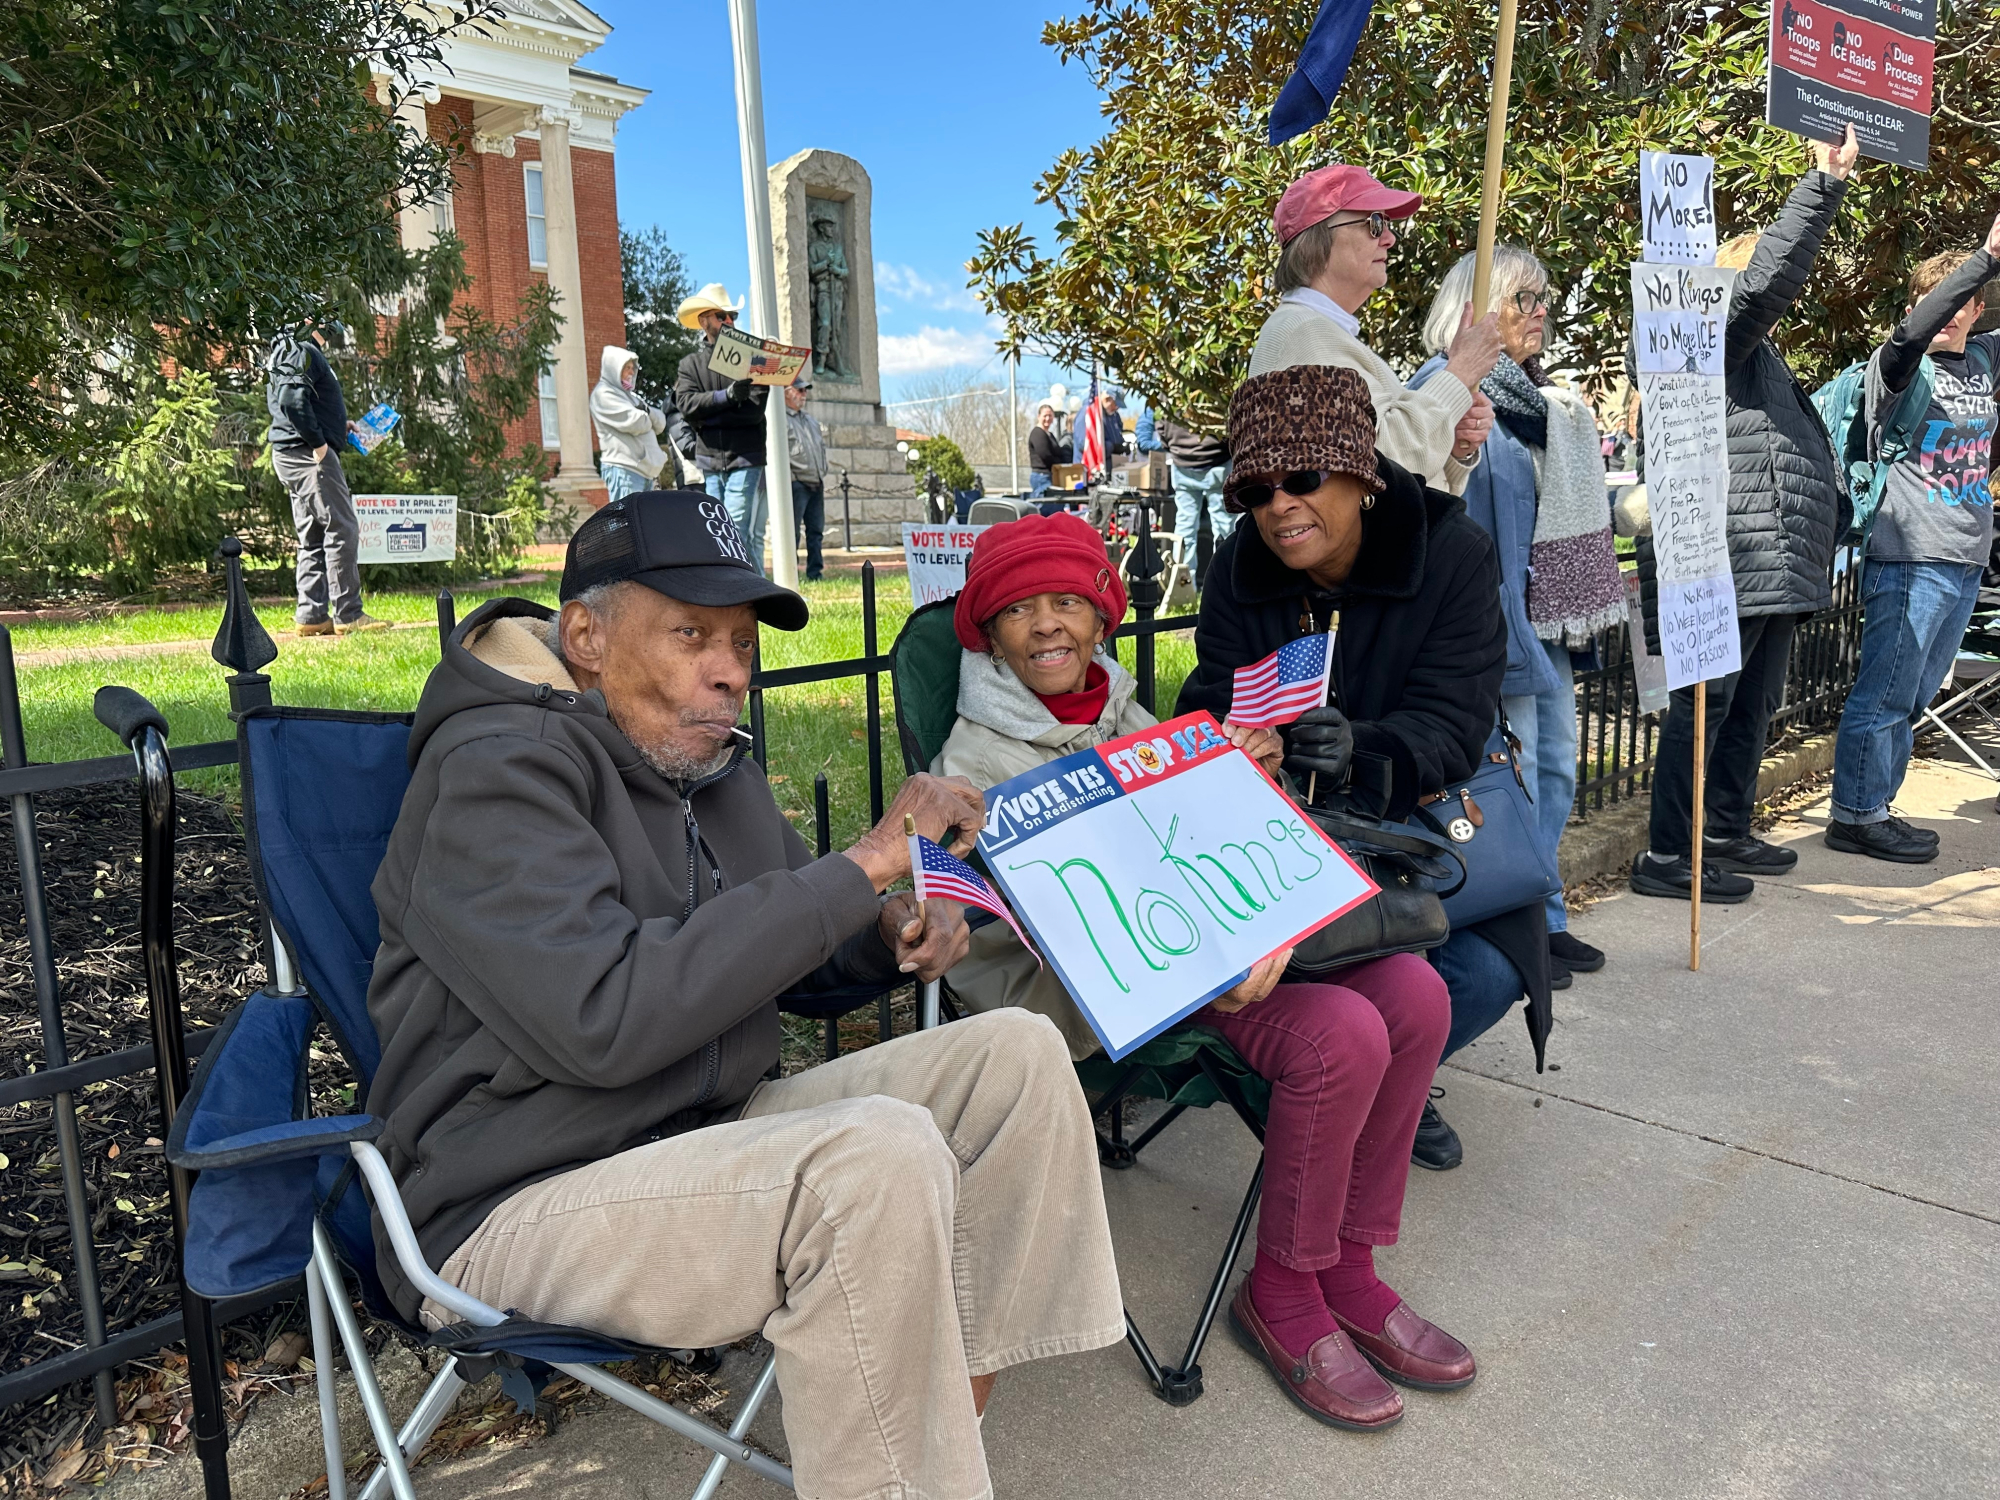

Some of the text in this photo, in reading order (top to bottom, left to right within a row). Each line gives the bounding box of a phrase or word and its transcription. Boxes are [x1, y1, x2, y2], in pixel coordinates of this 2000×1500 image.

[1879, 0, 1900, 13] POLICE
[1901, 7, 1923, 21] POWER
[1797, 13, 1812, 30] NO
[1787, 26, 1820, 52] Troops
[1846, 31, 1862, 48] NO
[1831, 43, 1876, 71] ICE Raids
[1893, 47, 1914, 65] Due
[1885, 62, 1923, 86] Process
[1796, 87, 1905, 132] The Constitution is CLEAR:
[1664, 160, 1688, 189] NO
[1678, 269, 1724, 315] Kings
[1696, 320, 1717, 349] ICE
[717, 345, 742, 366] NO
[765, 342, 790, 355] STOP
[1662, 415, 1692, 430] Freedom
[1665, 449, 1697, 464] Freedom
[1669, 477, 1688, 494] Right
[1690, 476, 1700, 486] to
[356, 498, 378, 507] VOTE
[381, 498, 397, 507] YES
[400, 499, 411, 507] BY
[413, 499, 436, 507] APRIL
[1670, 495, 1684, 509] Free
[431, 517, 455, 532] Vote
[1671, 511, 1689, 529] Due
[359, 535, 382, 549] YES
[911, 531, 974, 548] VOTE YES
[712, 536, 753, 567] ME
[912, 552, 963, 565] TO LEVEL
[920, 584, 953, 605] Vote
[1683, 590, 1696, 607] No
[1662, 613, 1674, 638] No
[1680, 656, 1694, 676] NO
[1108, 737, 1175, 784] STOP
[1170, 721, 1229, 762] ICE
[1001, 764, 1106, 823] VOTE YES
[1023, 785, 1116, 830] On Redistricting
